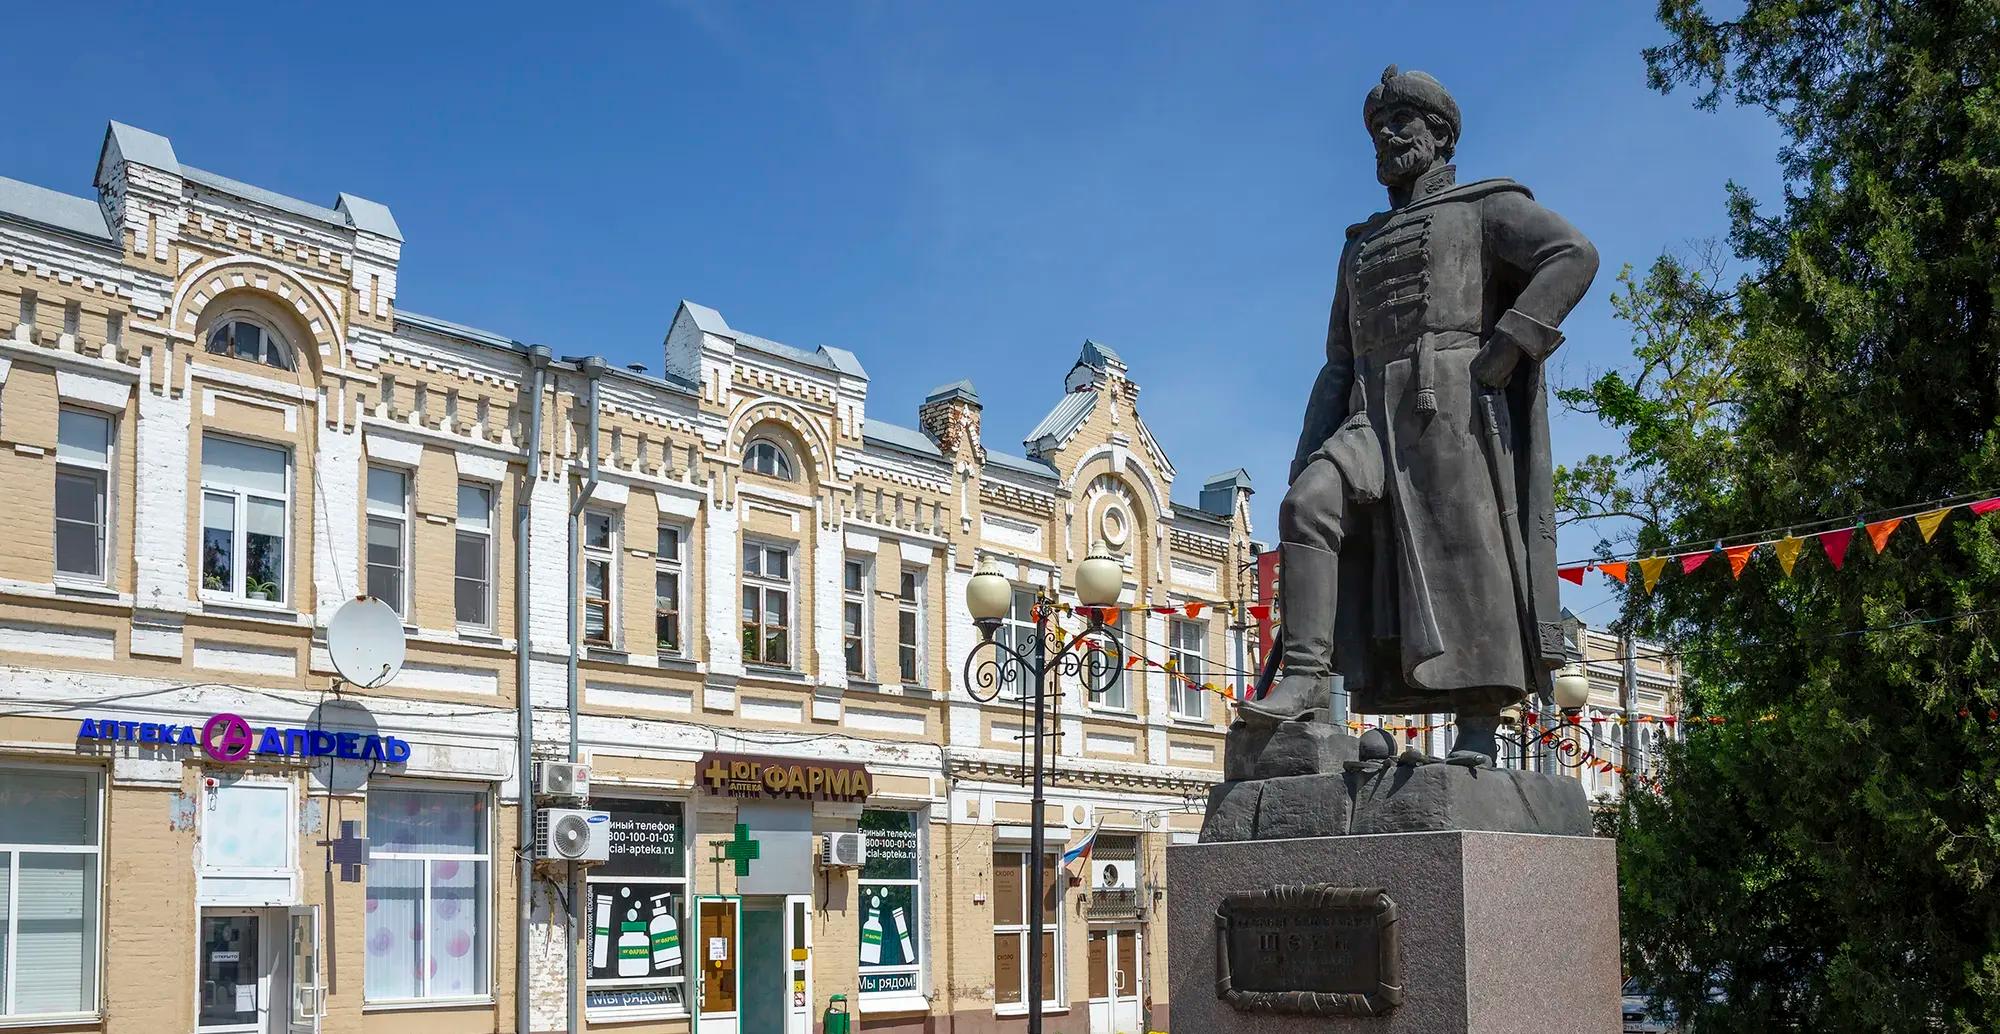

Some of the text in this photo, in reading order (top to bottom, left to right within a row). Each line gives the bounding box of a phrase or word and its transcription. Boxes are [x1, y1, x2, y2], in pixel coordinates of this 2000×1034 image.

[79, 718, 198, 746] АПТЕКА
[257, 726, 411, 762] АПРЕЛЬ
[729, 760, 761, 780] ЮГ
[763, 764, 871, 796] ФАРМА
[729, 782, 762, 793] АПТЕКА
[609, 820, 675, 833] иный телефон
[608, 832, 674, 843] 800-100-01-03
[887, 830, 917, 840] телефон
[609, 843, 674, 856] cial-apteka.ru
[865, 838, 916, 849] 800-100-01-03
[866, 848, 916, 860] cial-apteka.ru
[858, 973, 916, 991] Мы рядом!
[592, 988, 672, 1006] Мы рядом!
